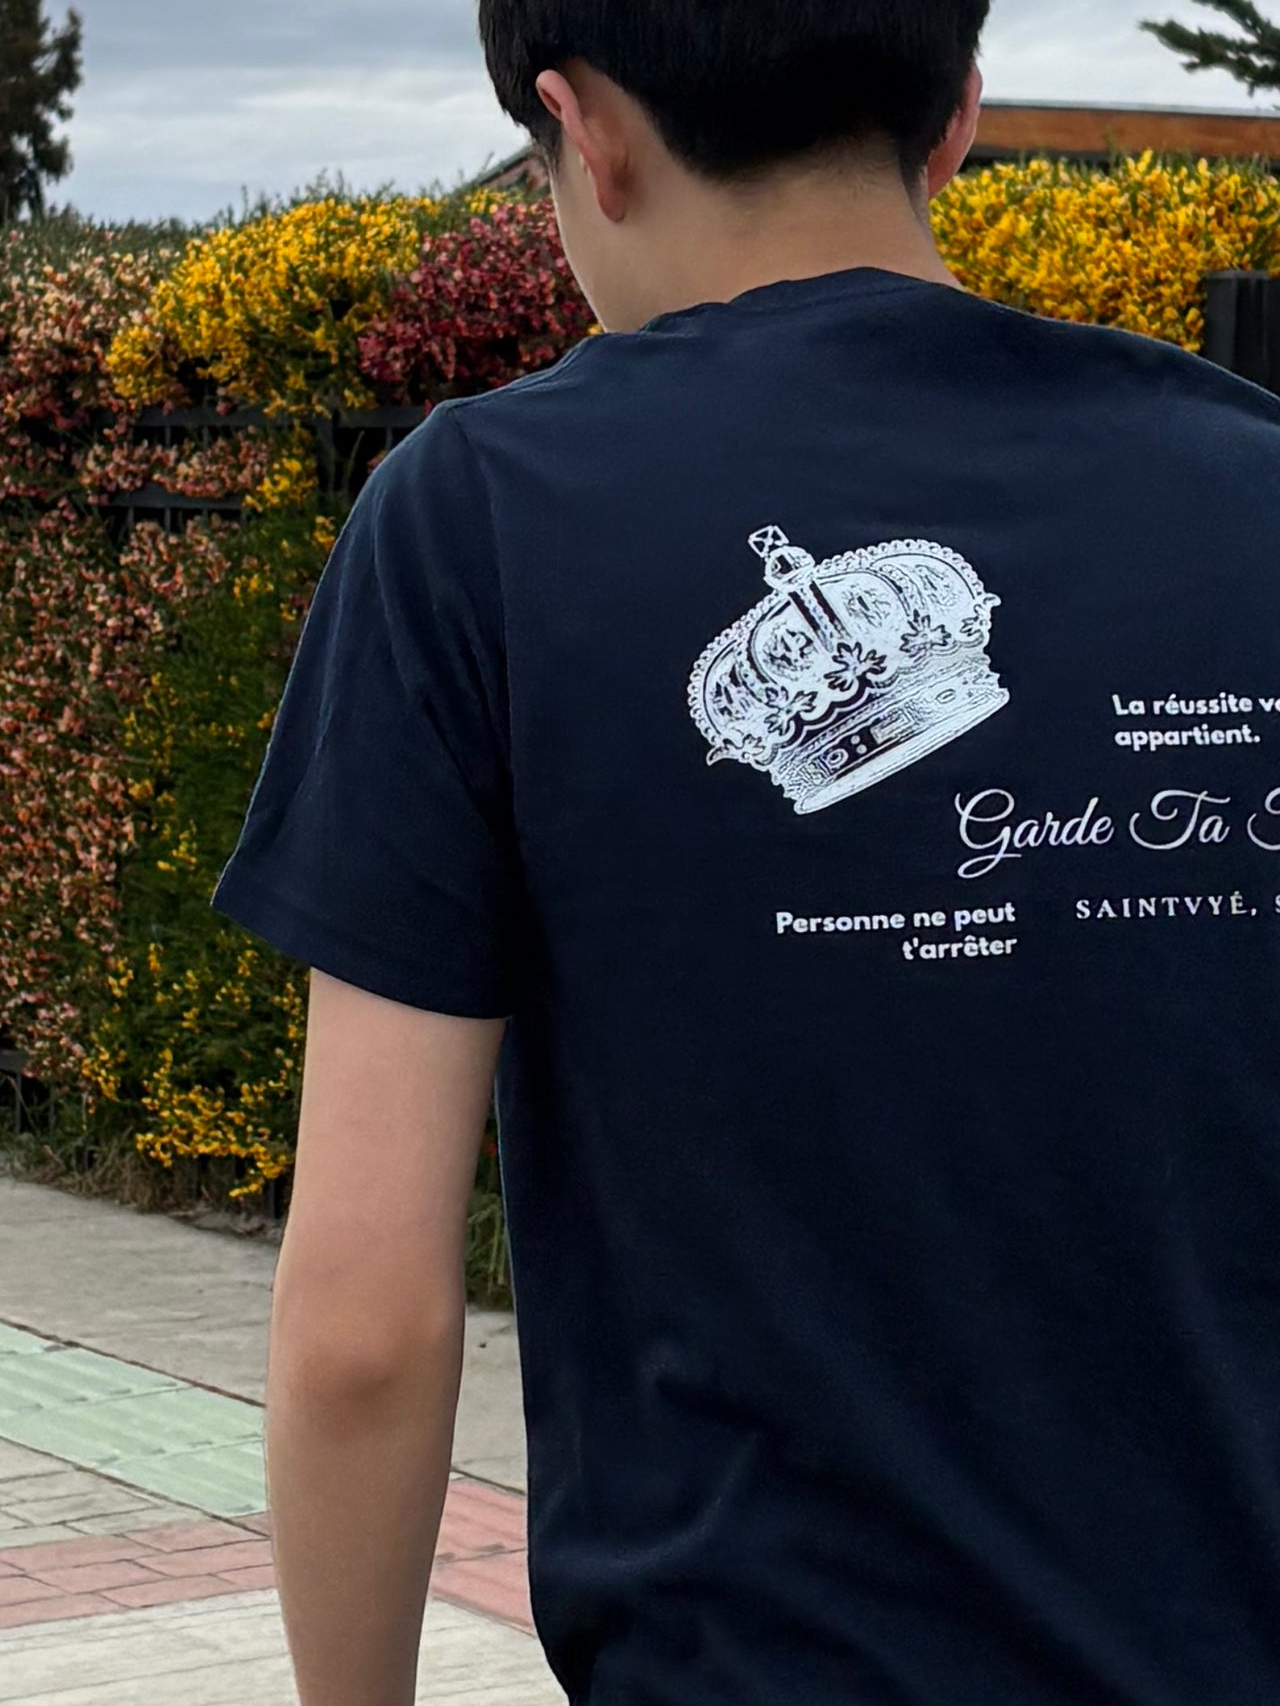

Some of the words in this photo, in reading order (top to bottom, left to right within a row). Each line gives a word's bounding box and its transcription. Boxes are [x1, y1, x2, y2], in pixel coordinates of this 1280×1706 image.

[1112, 694, 1145, 715] La
[1152, 692, 1253, 715] réussite
[1114, 723, 1261, 752] appartient.
[955, 788, 1115, 879] Garde
[1129, 789, 1231, 850] Ta
[775, 911, 906, 934] Personne
[913, 911, 947, 927] ne
[954, 902, 1016, 932] peut
[902, 934, 1018, 961] t'arrêter
